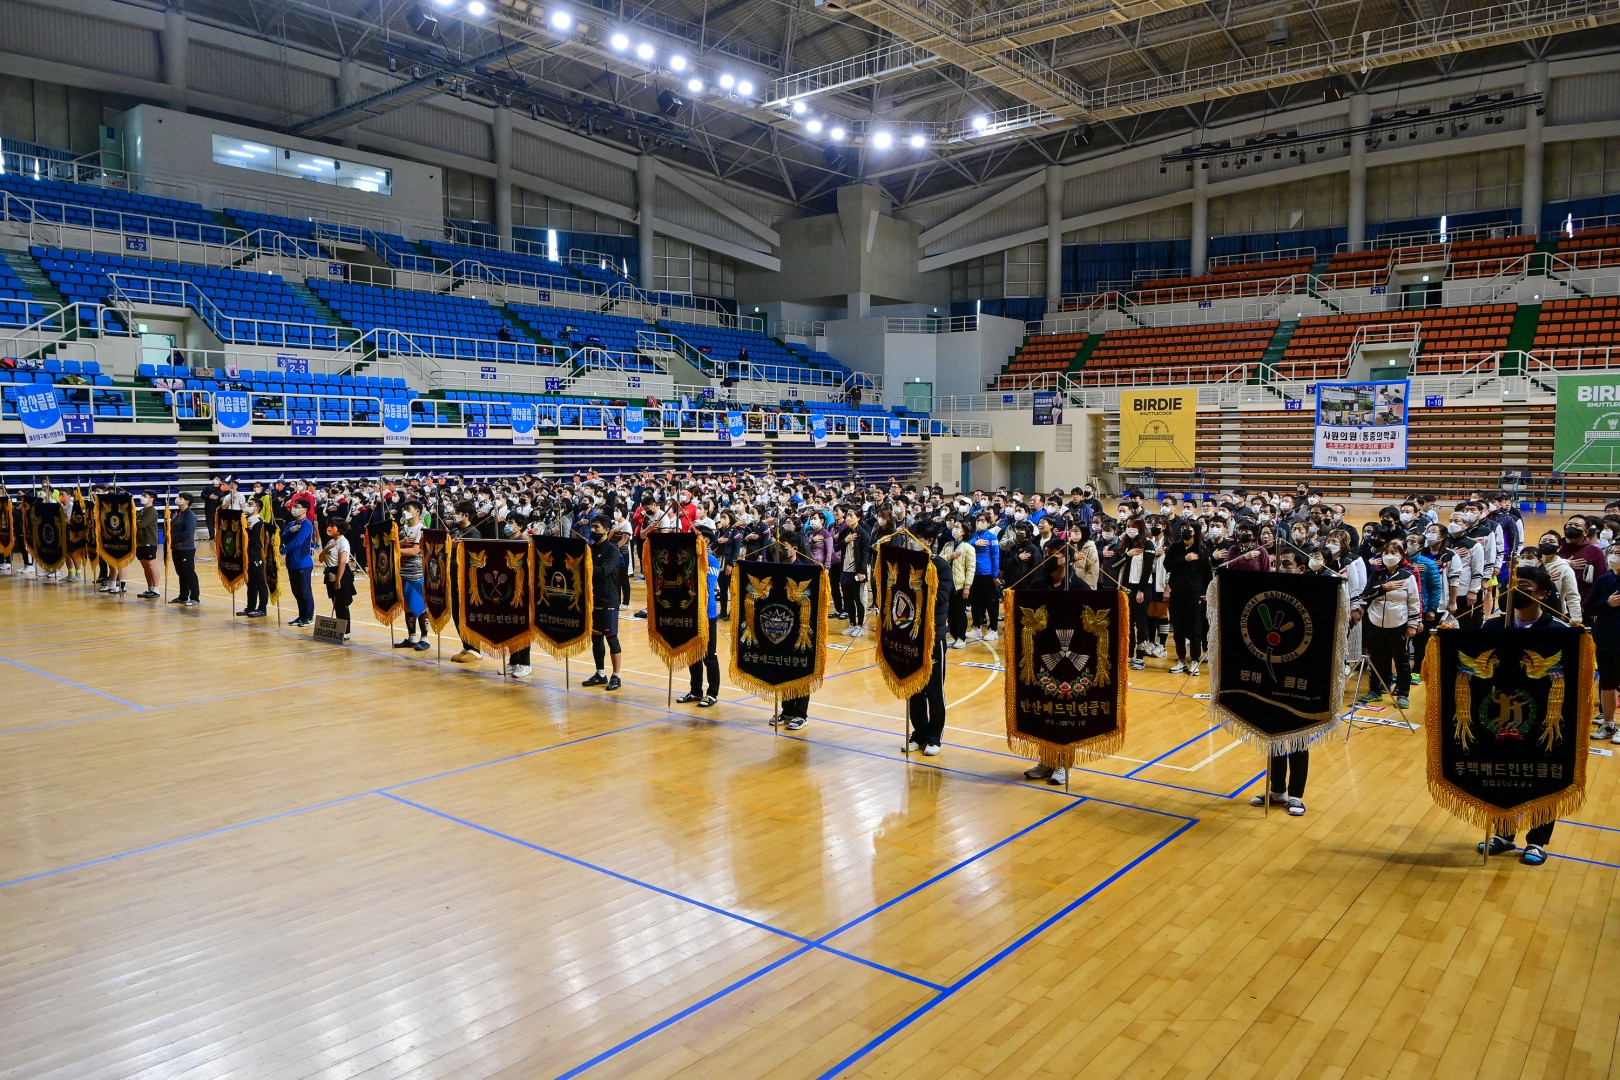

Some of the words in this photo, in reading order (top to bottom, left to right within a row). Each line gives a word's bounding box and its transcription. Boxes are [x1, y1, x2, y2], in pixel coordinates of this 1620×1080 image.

[130, 242, 144, 250] 4-2
[289, 365, 305, 373] 2-3
[548, 382, 558, 390] 2-4
[18, 392, 57, 413] 장산클럽
[217, 397, 248, 412] 재송클럽
[1134, 397, 1182, 411] BIRDIE
[385, 404, 408, 418] 좌동클럽
[66, 422, 87, 432] 1-1
[295, 427, 313, 435] 1-2
[470, 429, 484, 437] 1-3
[609, 431, 620, 439] 1-4
[1241, 597, 1259, 629] DONGHAE
[1264, 592, 1307, 615] BADMINTON
[1304, 617, 1312, 637] CLUB
[1280, 652, 1299, 662] 2004
[1240, 669, 1262, 684] 동해
[1283, 676, 1308, 691] 클럽
[1020, 700, 1111, 717] 반산배드민턴클럽
[1454, 761, 1563, 779] 동백배드민턴클럽
